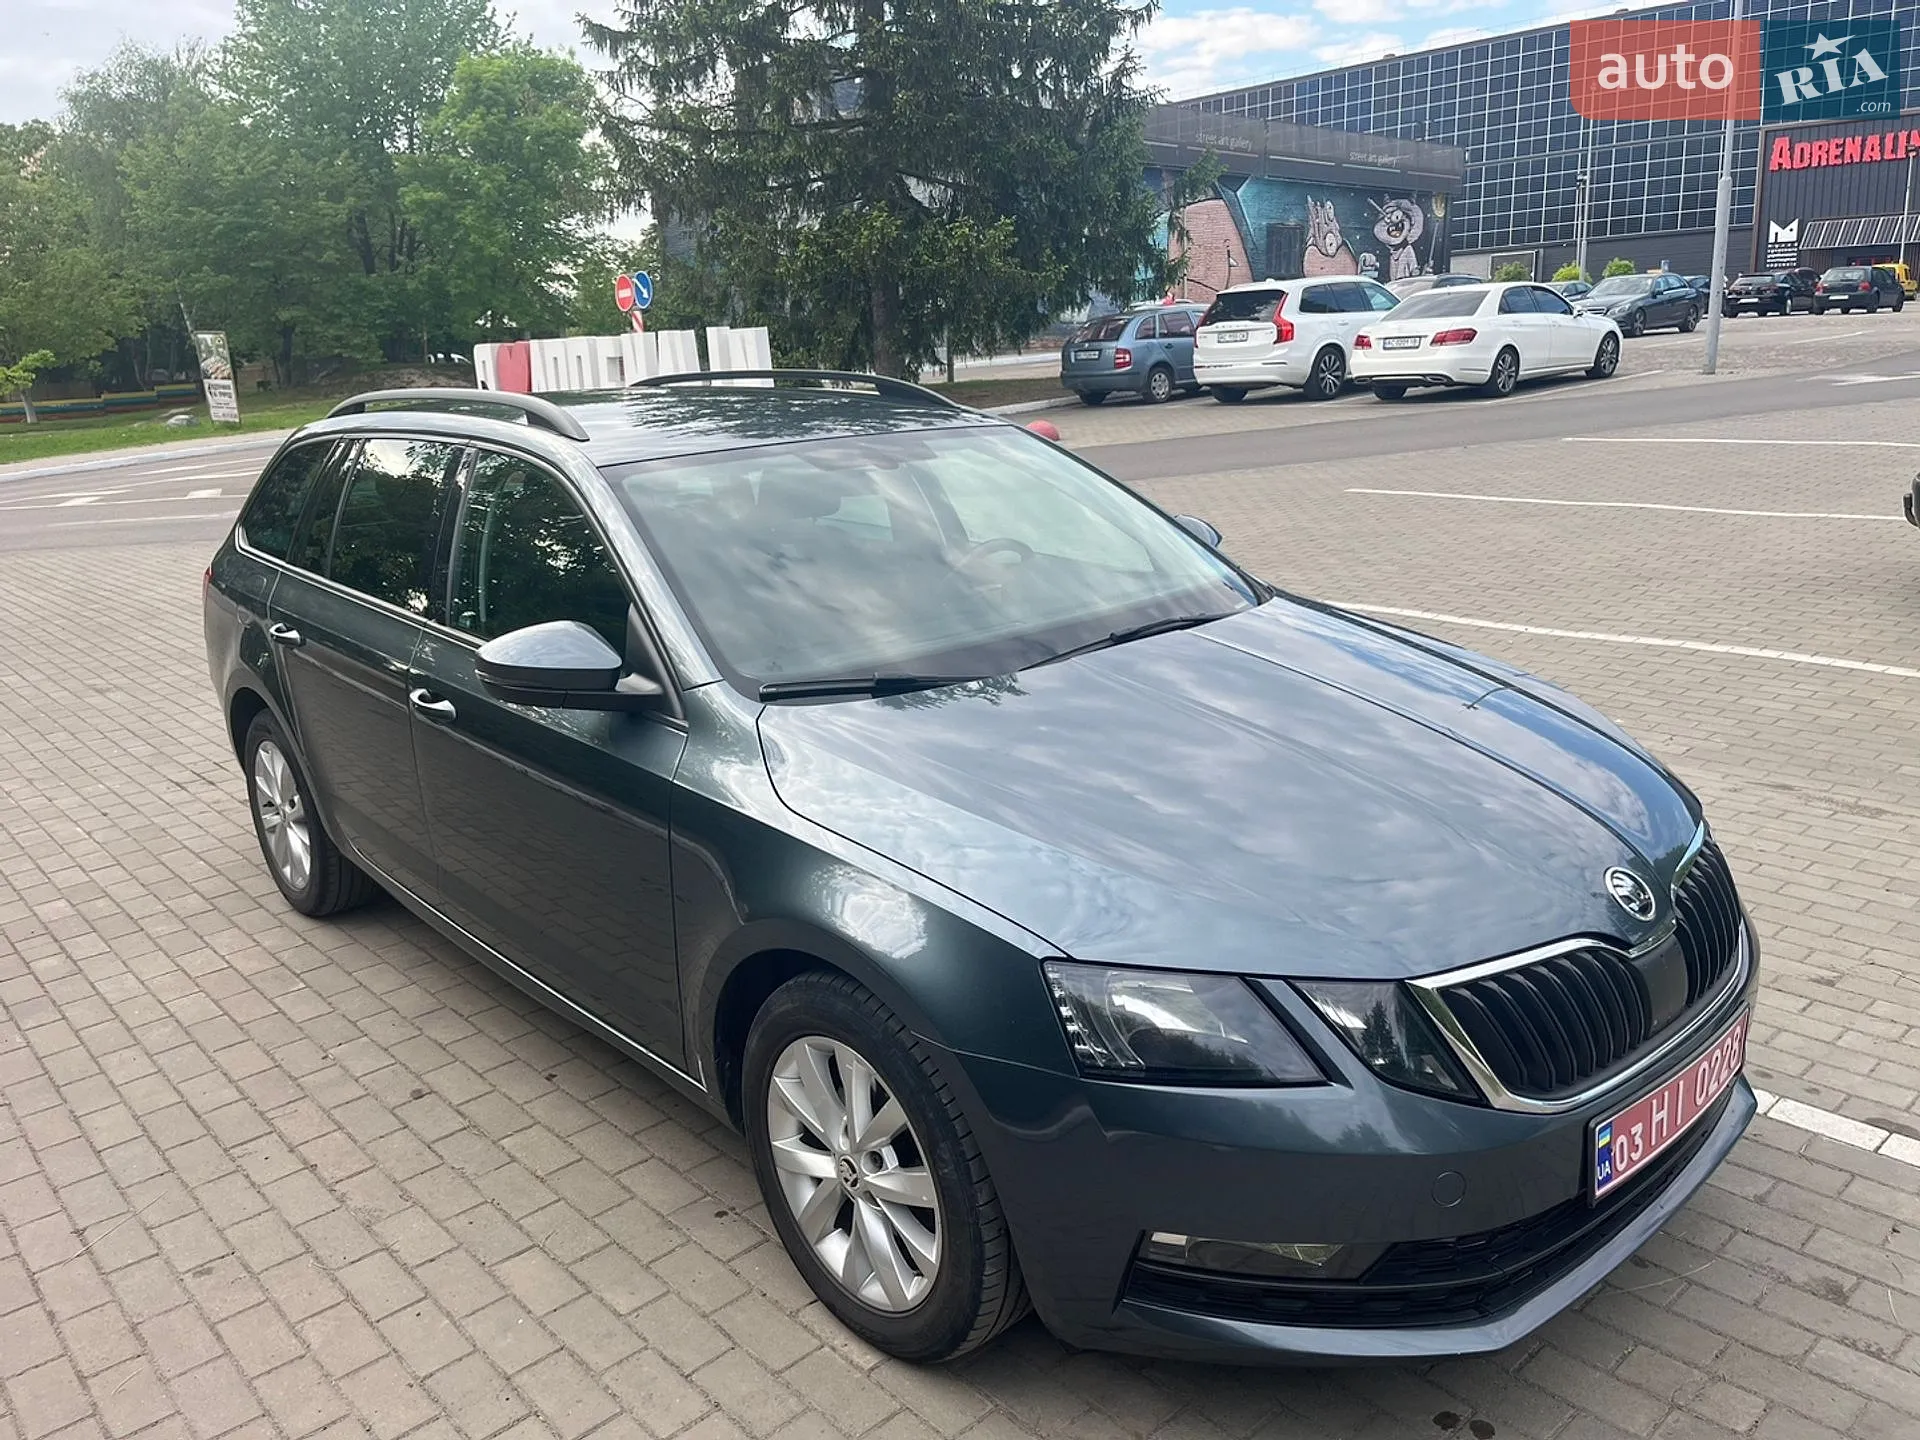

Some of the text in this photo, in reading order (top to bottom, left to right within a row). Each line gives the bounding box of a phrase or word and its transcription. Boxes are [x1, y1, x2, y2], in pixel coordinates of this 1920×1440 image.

[1615, 1025, 1742, 1172] 03 HI 0228
[1597, 1161, 1611, 1180] UA
